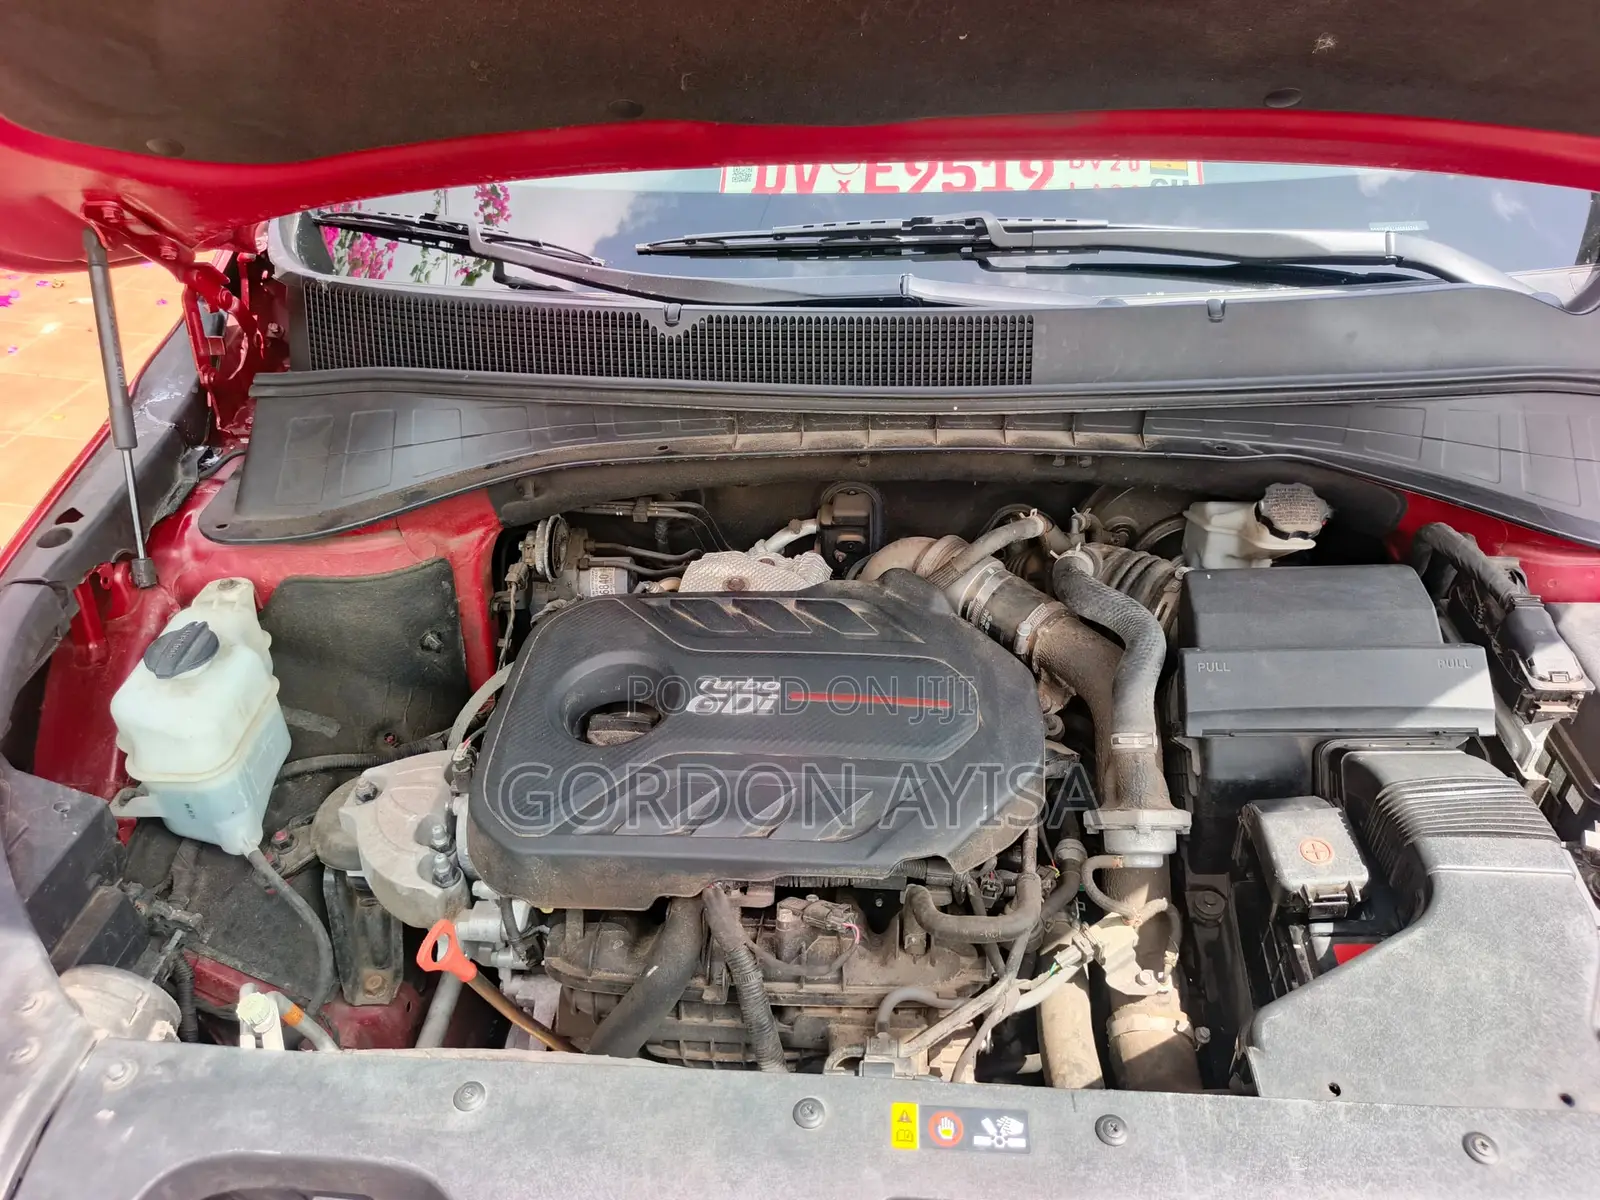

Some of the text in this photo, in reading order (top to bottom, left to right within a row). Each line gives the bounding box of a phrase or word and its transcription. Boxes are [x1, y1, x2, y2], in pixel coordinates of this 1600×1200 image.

[865, 159, 1055, 193] E9519
[1197, 662, 1231, 673] PULL
[1437, 658, 1472, 670] PULL
